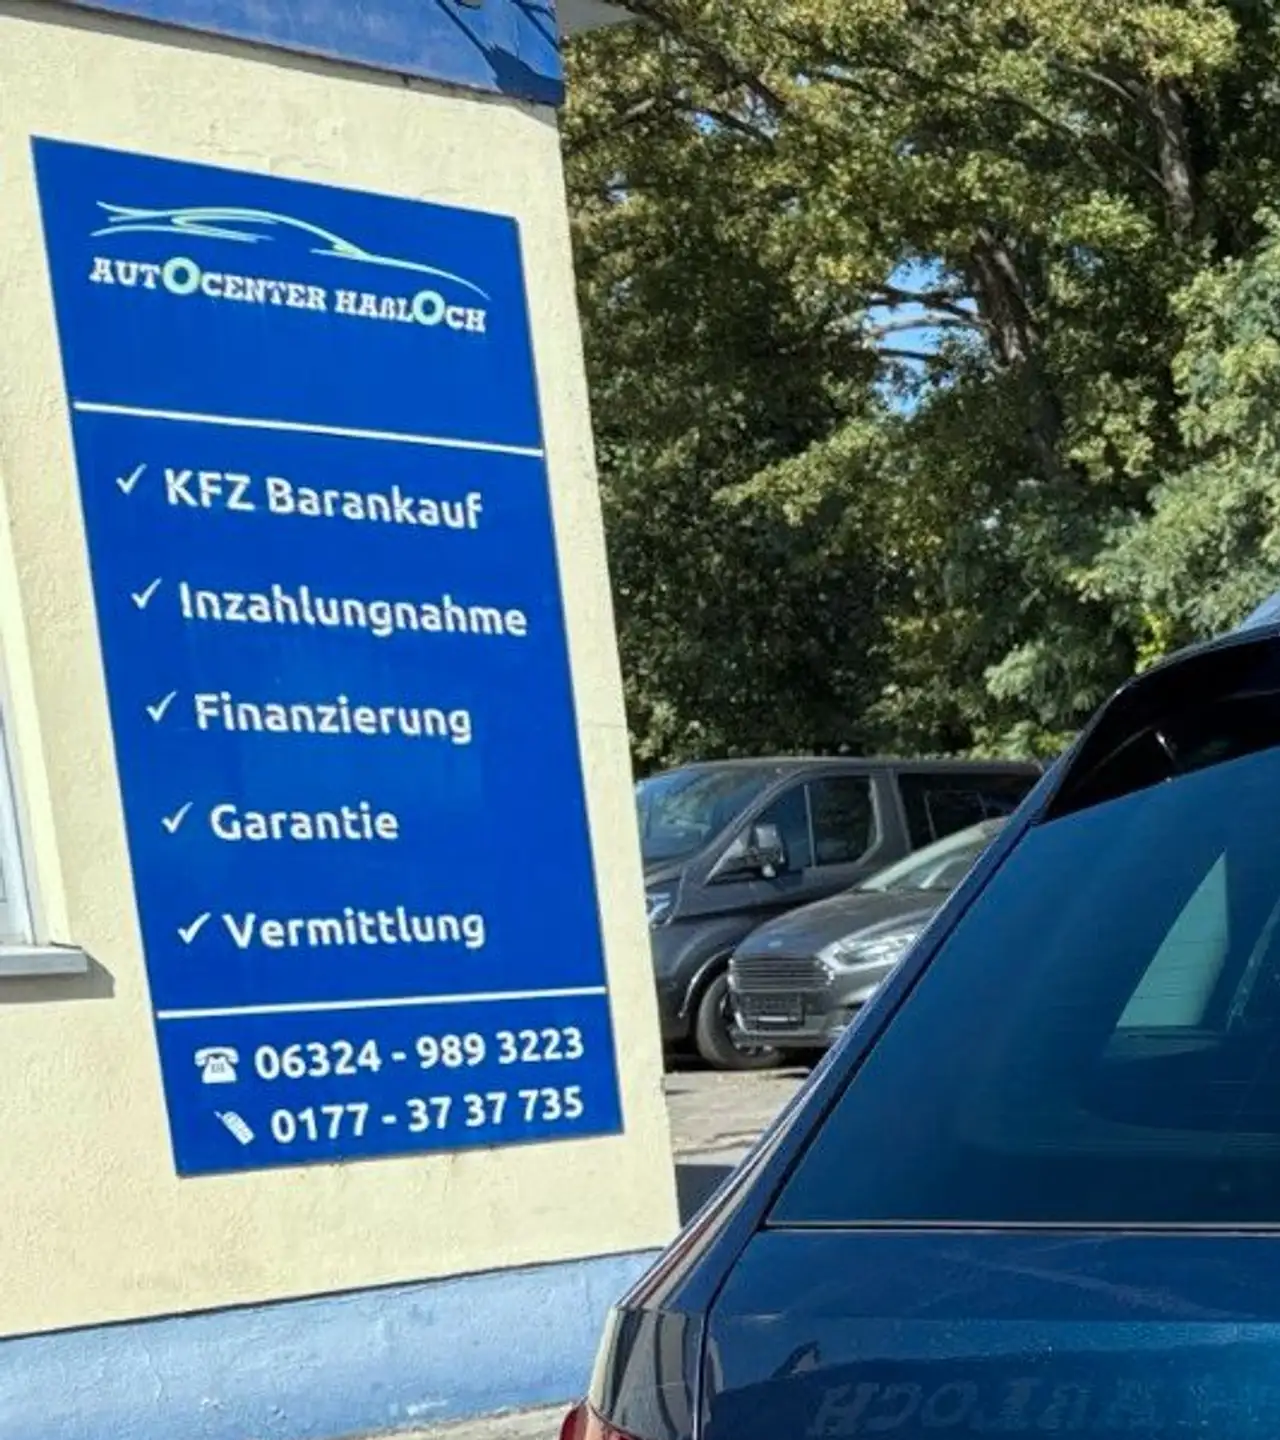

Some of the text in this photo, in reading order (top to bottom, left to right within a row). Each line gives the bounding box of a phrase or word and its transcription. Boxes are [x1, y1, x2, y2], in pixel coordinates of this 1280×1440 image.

[89, 257, 327, 311] AUTOCENTER
[165, 468, 482, 529] KFZ Barankauf
[180, 582, 527, 636] Inzahlungnahme
[194, 692, 472, 744] Finanzierung
[210, 801, 399, 841] Garantie
[222, 906, 485, 949] Vermittlung
[255, 1039, 381, 1079] 06324
[416, 1033, 485, 1069] 989
[497, 1027, 584, 1064] 3223
[271, 1103, 368, 1143] 0177
[407, 1096, 451, 1132] 37
[464, 1091, 507, 1127] 37
[519, 1086, 583, 1121] 735
